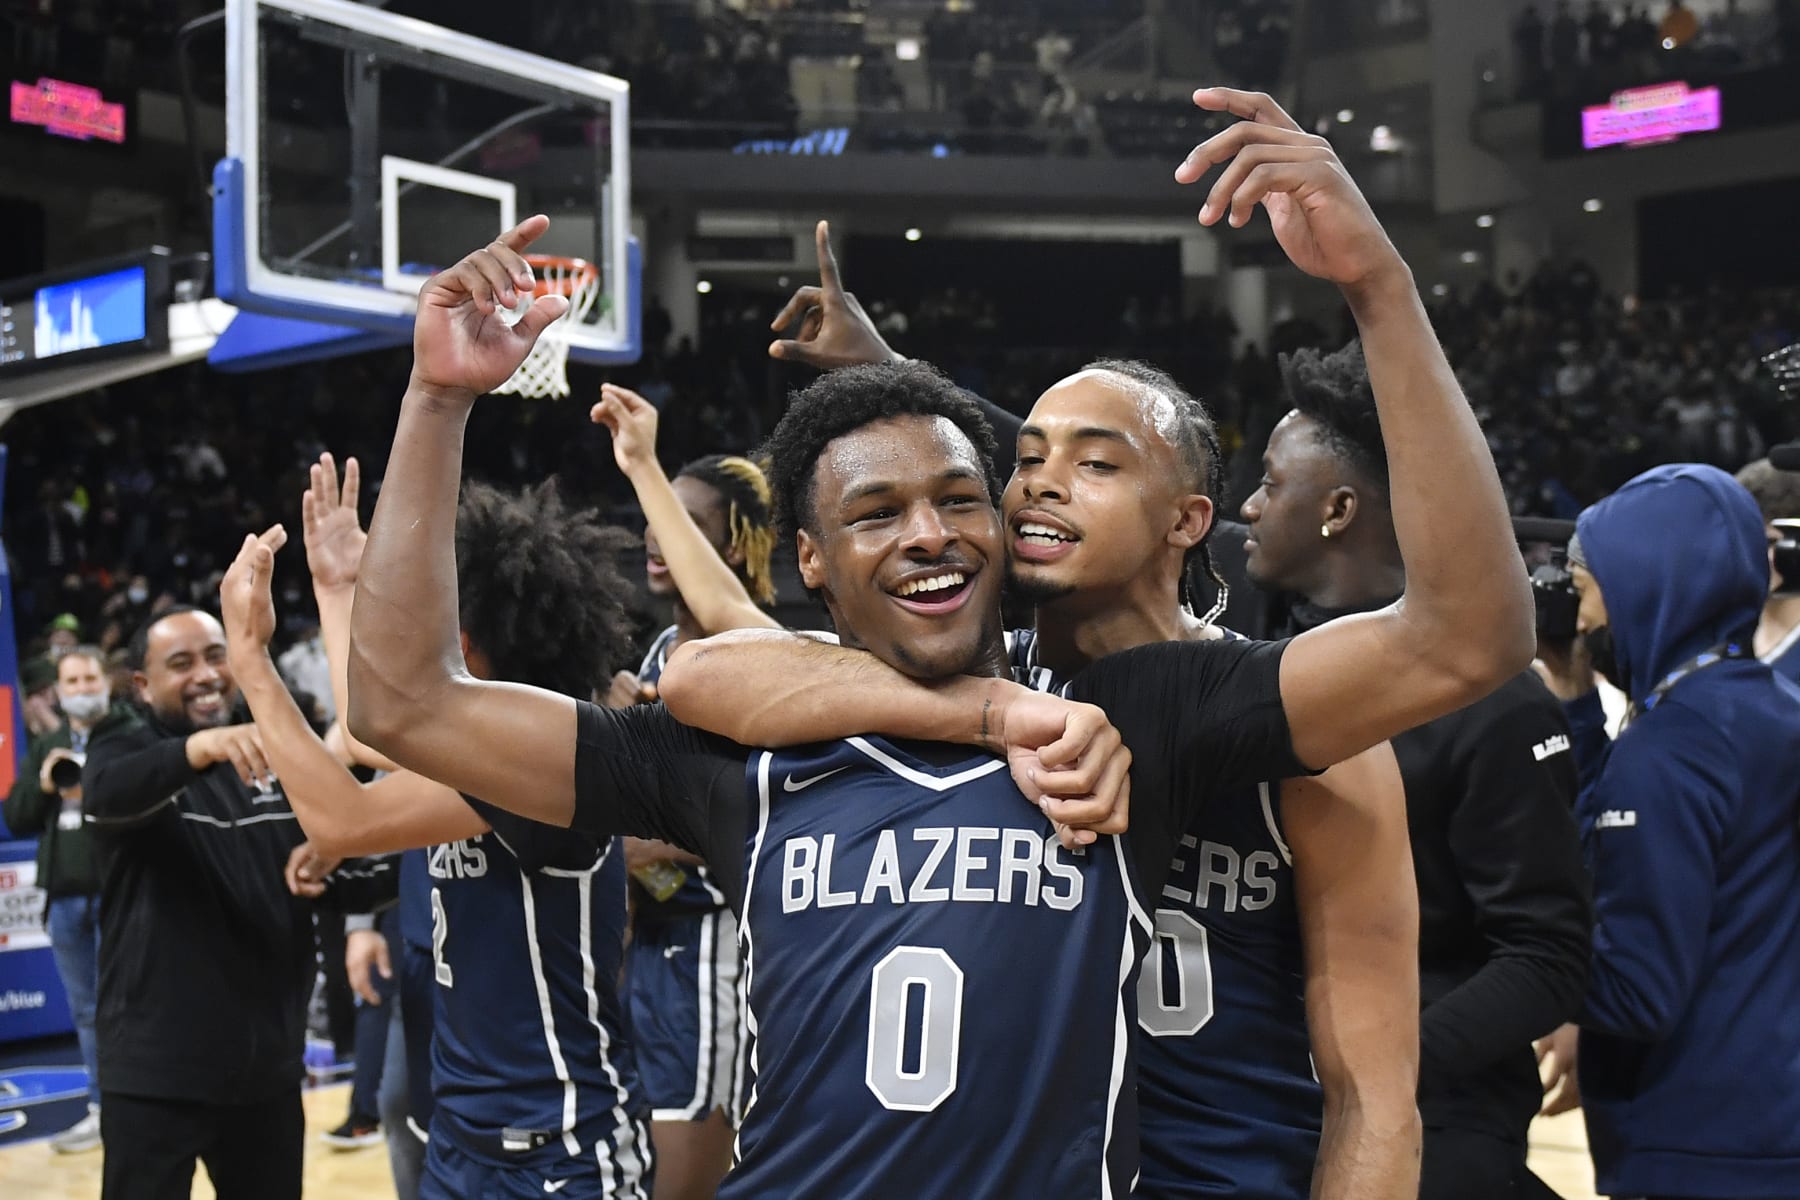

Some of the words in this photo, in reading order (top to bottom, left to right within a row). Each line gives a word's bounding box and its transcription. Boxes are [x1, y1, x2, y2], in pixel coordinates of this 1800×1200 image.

[782, 827, 1085, 914] BLAZERS
[865, 945, 965, 1113] 0
[1137, 908, 1215, 1037] 0
